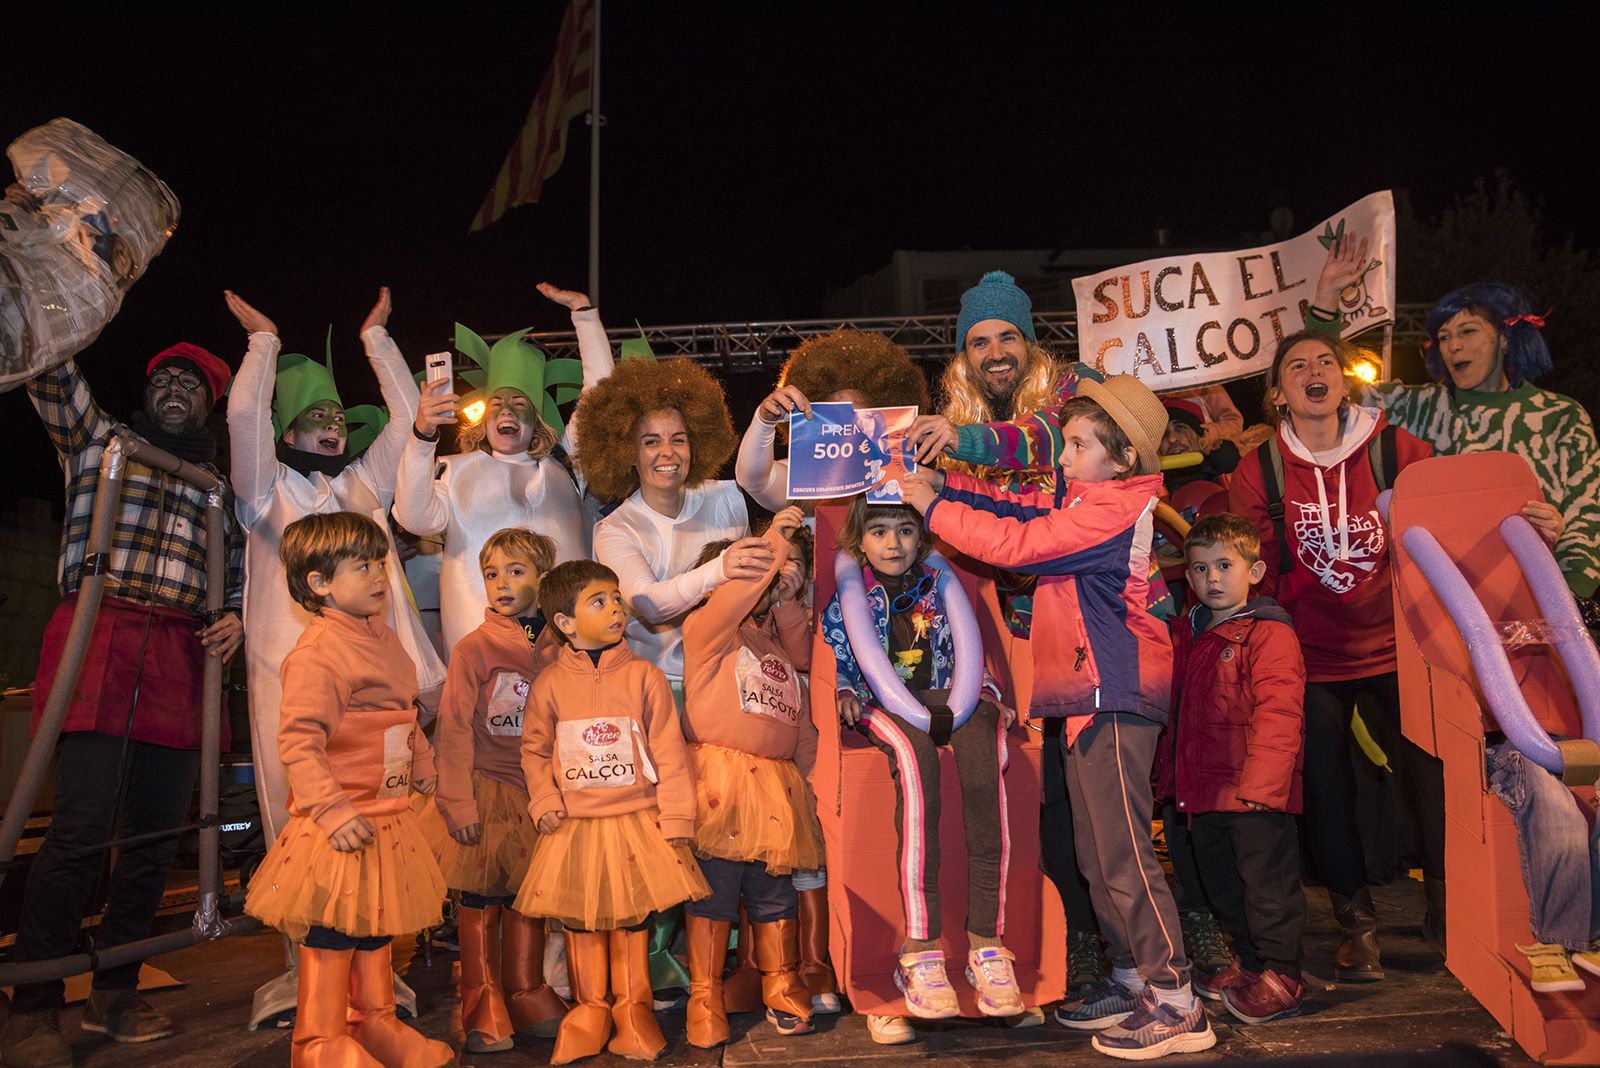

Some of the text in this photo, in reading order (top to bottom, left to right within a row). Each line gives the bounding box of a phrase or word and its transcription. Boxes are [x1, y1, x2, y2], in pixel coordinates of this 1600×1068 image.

[1092, 251, 1307, 324] SUCA EL
[814, 439, 870, 459] 500 €
[761, 683, 784, 699] SALSA
[743, 690, 797, 721] ALÇOTS
[588, 753, 619, 764] SALSA
[565, 763, 635, 781] CALÇOT
